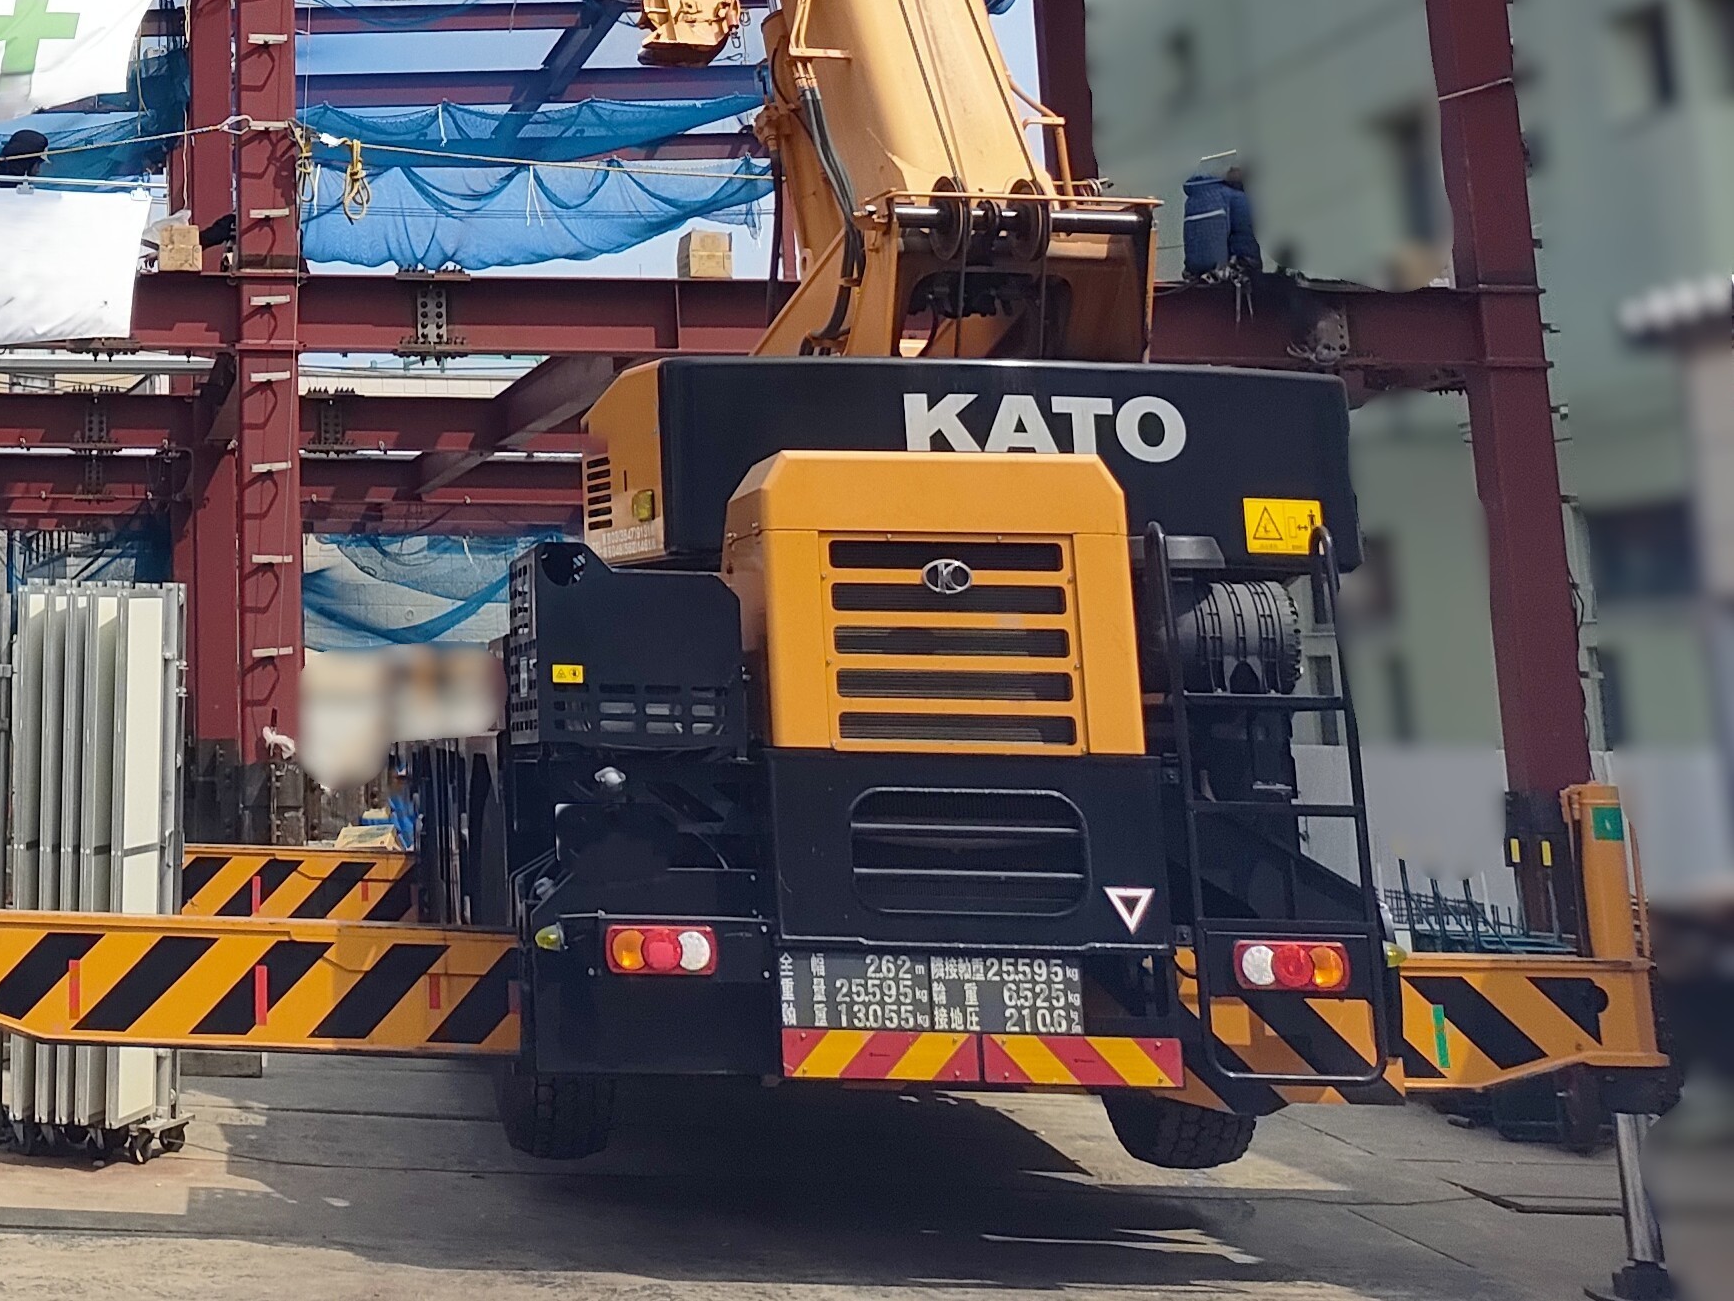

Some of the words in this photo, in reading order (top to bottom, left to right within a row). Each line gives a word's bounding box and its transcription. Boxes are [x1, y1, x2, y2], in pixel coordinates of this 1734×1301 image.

[903, 393, 1186, 463] KATO
[915, 964, 925, 975] m
[1065, 965, 1079, 981] kg
[915, 987, 928, 1003] kg
[1067, 991, 1081, 1007] kg
[916, 1012, 929, 1028] kg
[933, 1007, 981, 1031] 接地圧
